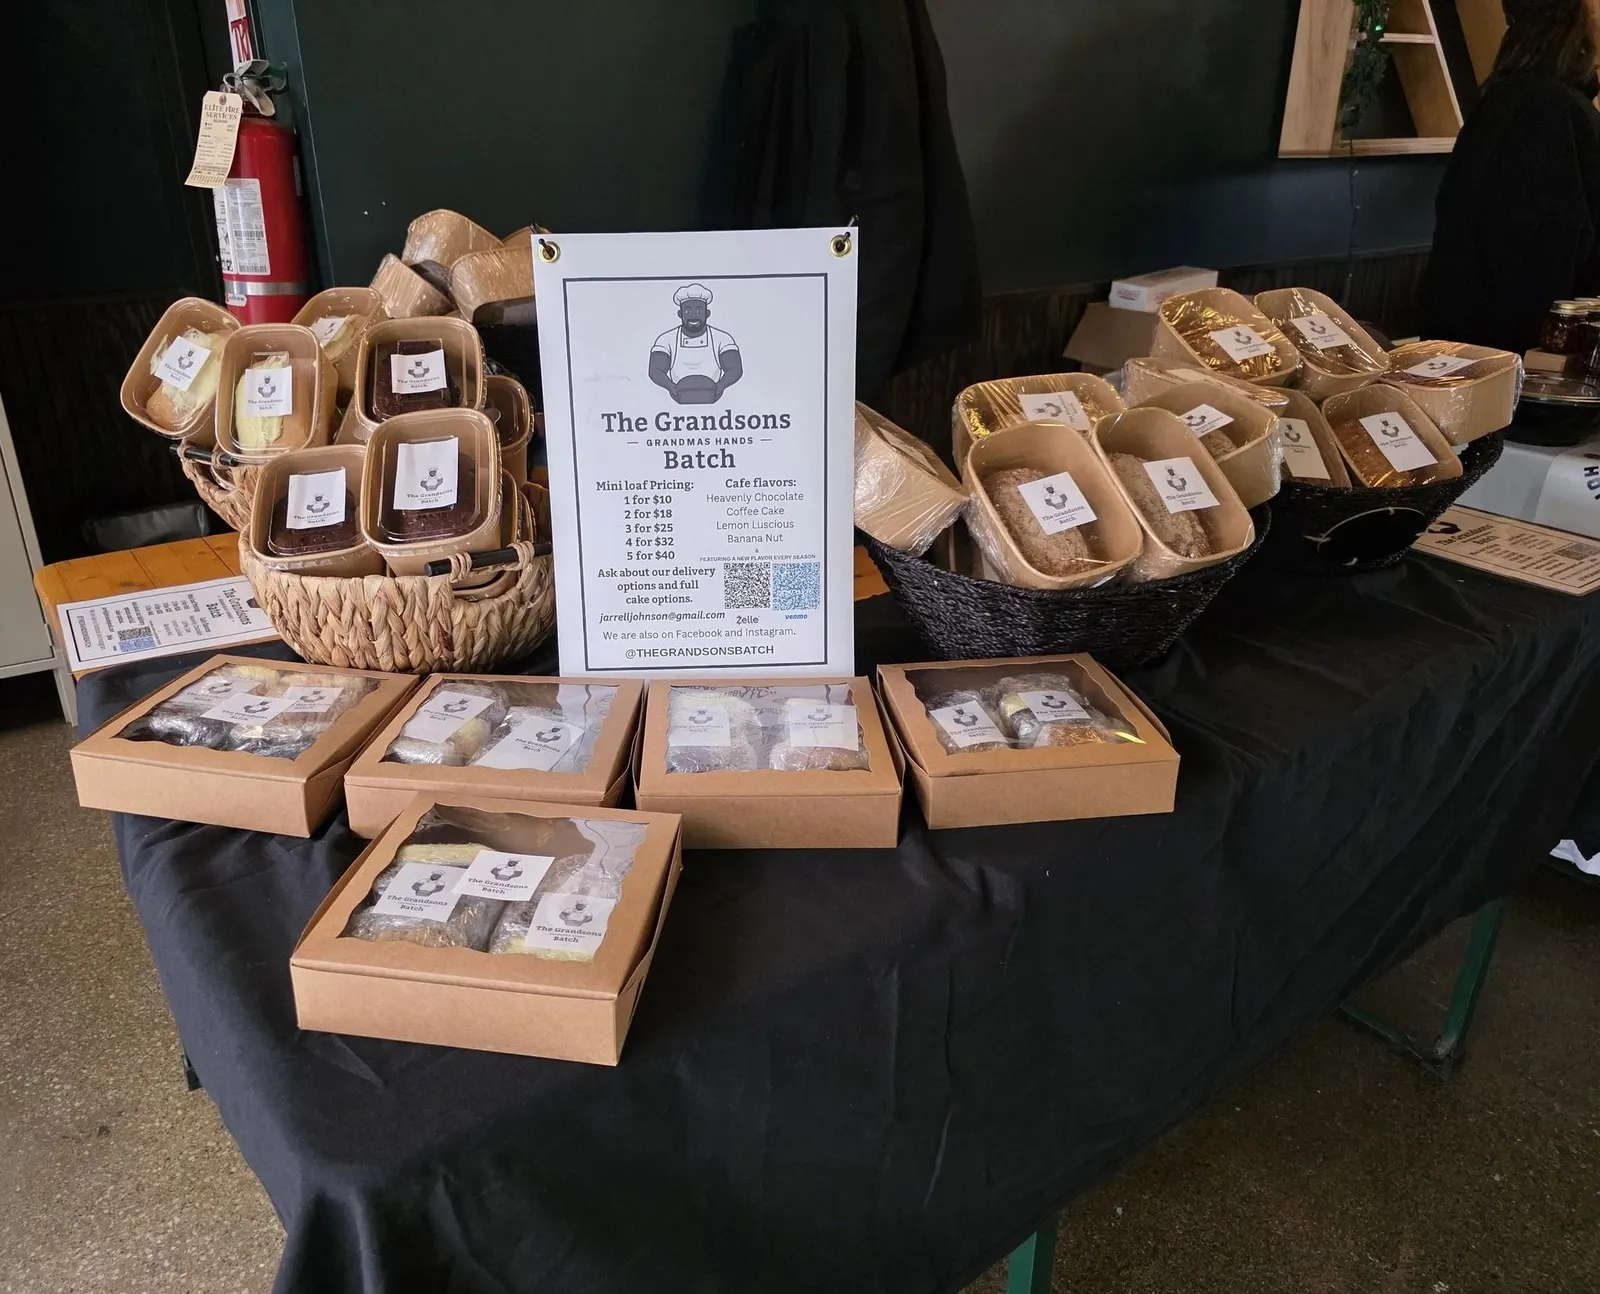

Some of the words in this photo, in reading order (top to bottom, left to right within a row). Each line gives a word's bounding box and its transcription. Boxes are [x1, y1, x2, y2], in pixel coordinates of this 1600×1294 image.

[601, 411, 648, 432] The
[655, 409, 791, 431] Grandsons
[646, 438, 711, 447] GRANDMAS
[715, 437, 754, 445] HANDS
[664, 448, 736, 469] Batch
[596, 480, 622, 491] Mini
[625, 479, 648, 491] loaf
[650, 479, 694, 492] Pricing:
[725, 478, 751, 488] Cafe
[753, 477, 797, 488] flavors:
[624, 496, 630, 505] 1
[632, 495, 650, 504] for
[653, 494, 672, 504] $10
[706, 492, 752, 504] Heavenly
[754, 492, 804, 502] Chocolate
[624, 510, 631, 519] 2
[634, 508, 651, 518] for
[653, 508, 672, 519] $18
[726, 507, 759, 516] Coffee
[761, 506, 785, 515] Cake
[1053, 505, 1085, 518] Grandsons
[716, 521, 749, 530] Lemon
[752, 520, 795, 529] Luscious
[1059, 516, 1076, 525] Batch
[625, 524, 632, 533] 3
[634, 523, 652, 533] for
[654, 523, 674, 533] $25
[625, 538, 632, 547] 4
[635, 537, 653, 546] for
[655, 536, 675, 547] $32
[727, 534, 763, 543] Banana
[765, 533, 783, 543] Nut
[627, 552, 633, 561] 5
[636, 551, 653, 560] for
[655, 550, 675, 560] $40
[598, 568, 617, 578] Ask
[619, 568, 650, 577] about
[652, 569, 670, 577] our
[672, 566, 716, 577] delivery
[617, 581, 656, 593] options
[658, 580, 678, 590] and
[680, 580, 699, 590] full
[626, 595, 650, 604] cake
[651, 594, 693, 606] options.
[599, 610, 725, 624] jarrelljohnson@gmail.com
[736, 615, 759, 625] Zelle
[603, 631, 618, 640] We
[639, 630, 659, 639] also
[676, 628, 722, 638] Facebook
[724, 628, 742, 637] and
[745, 628, 796, 638] Instagram.
[625, 645, 774, 660] @THEGRANDSONSBATCH
[484, 879, 528, 889] Grandsons
[481, 887, 506, 895] Batch
[403, 896, 448, 906] Grandsons
[400, 904, 424, 912] Batch
[553, 927, 602, 937] Grandsons
